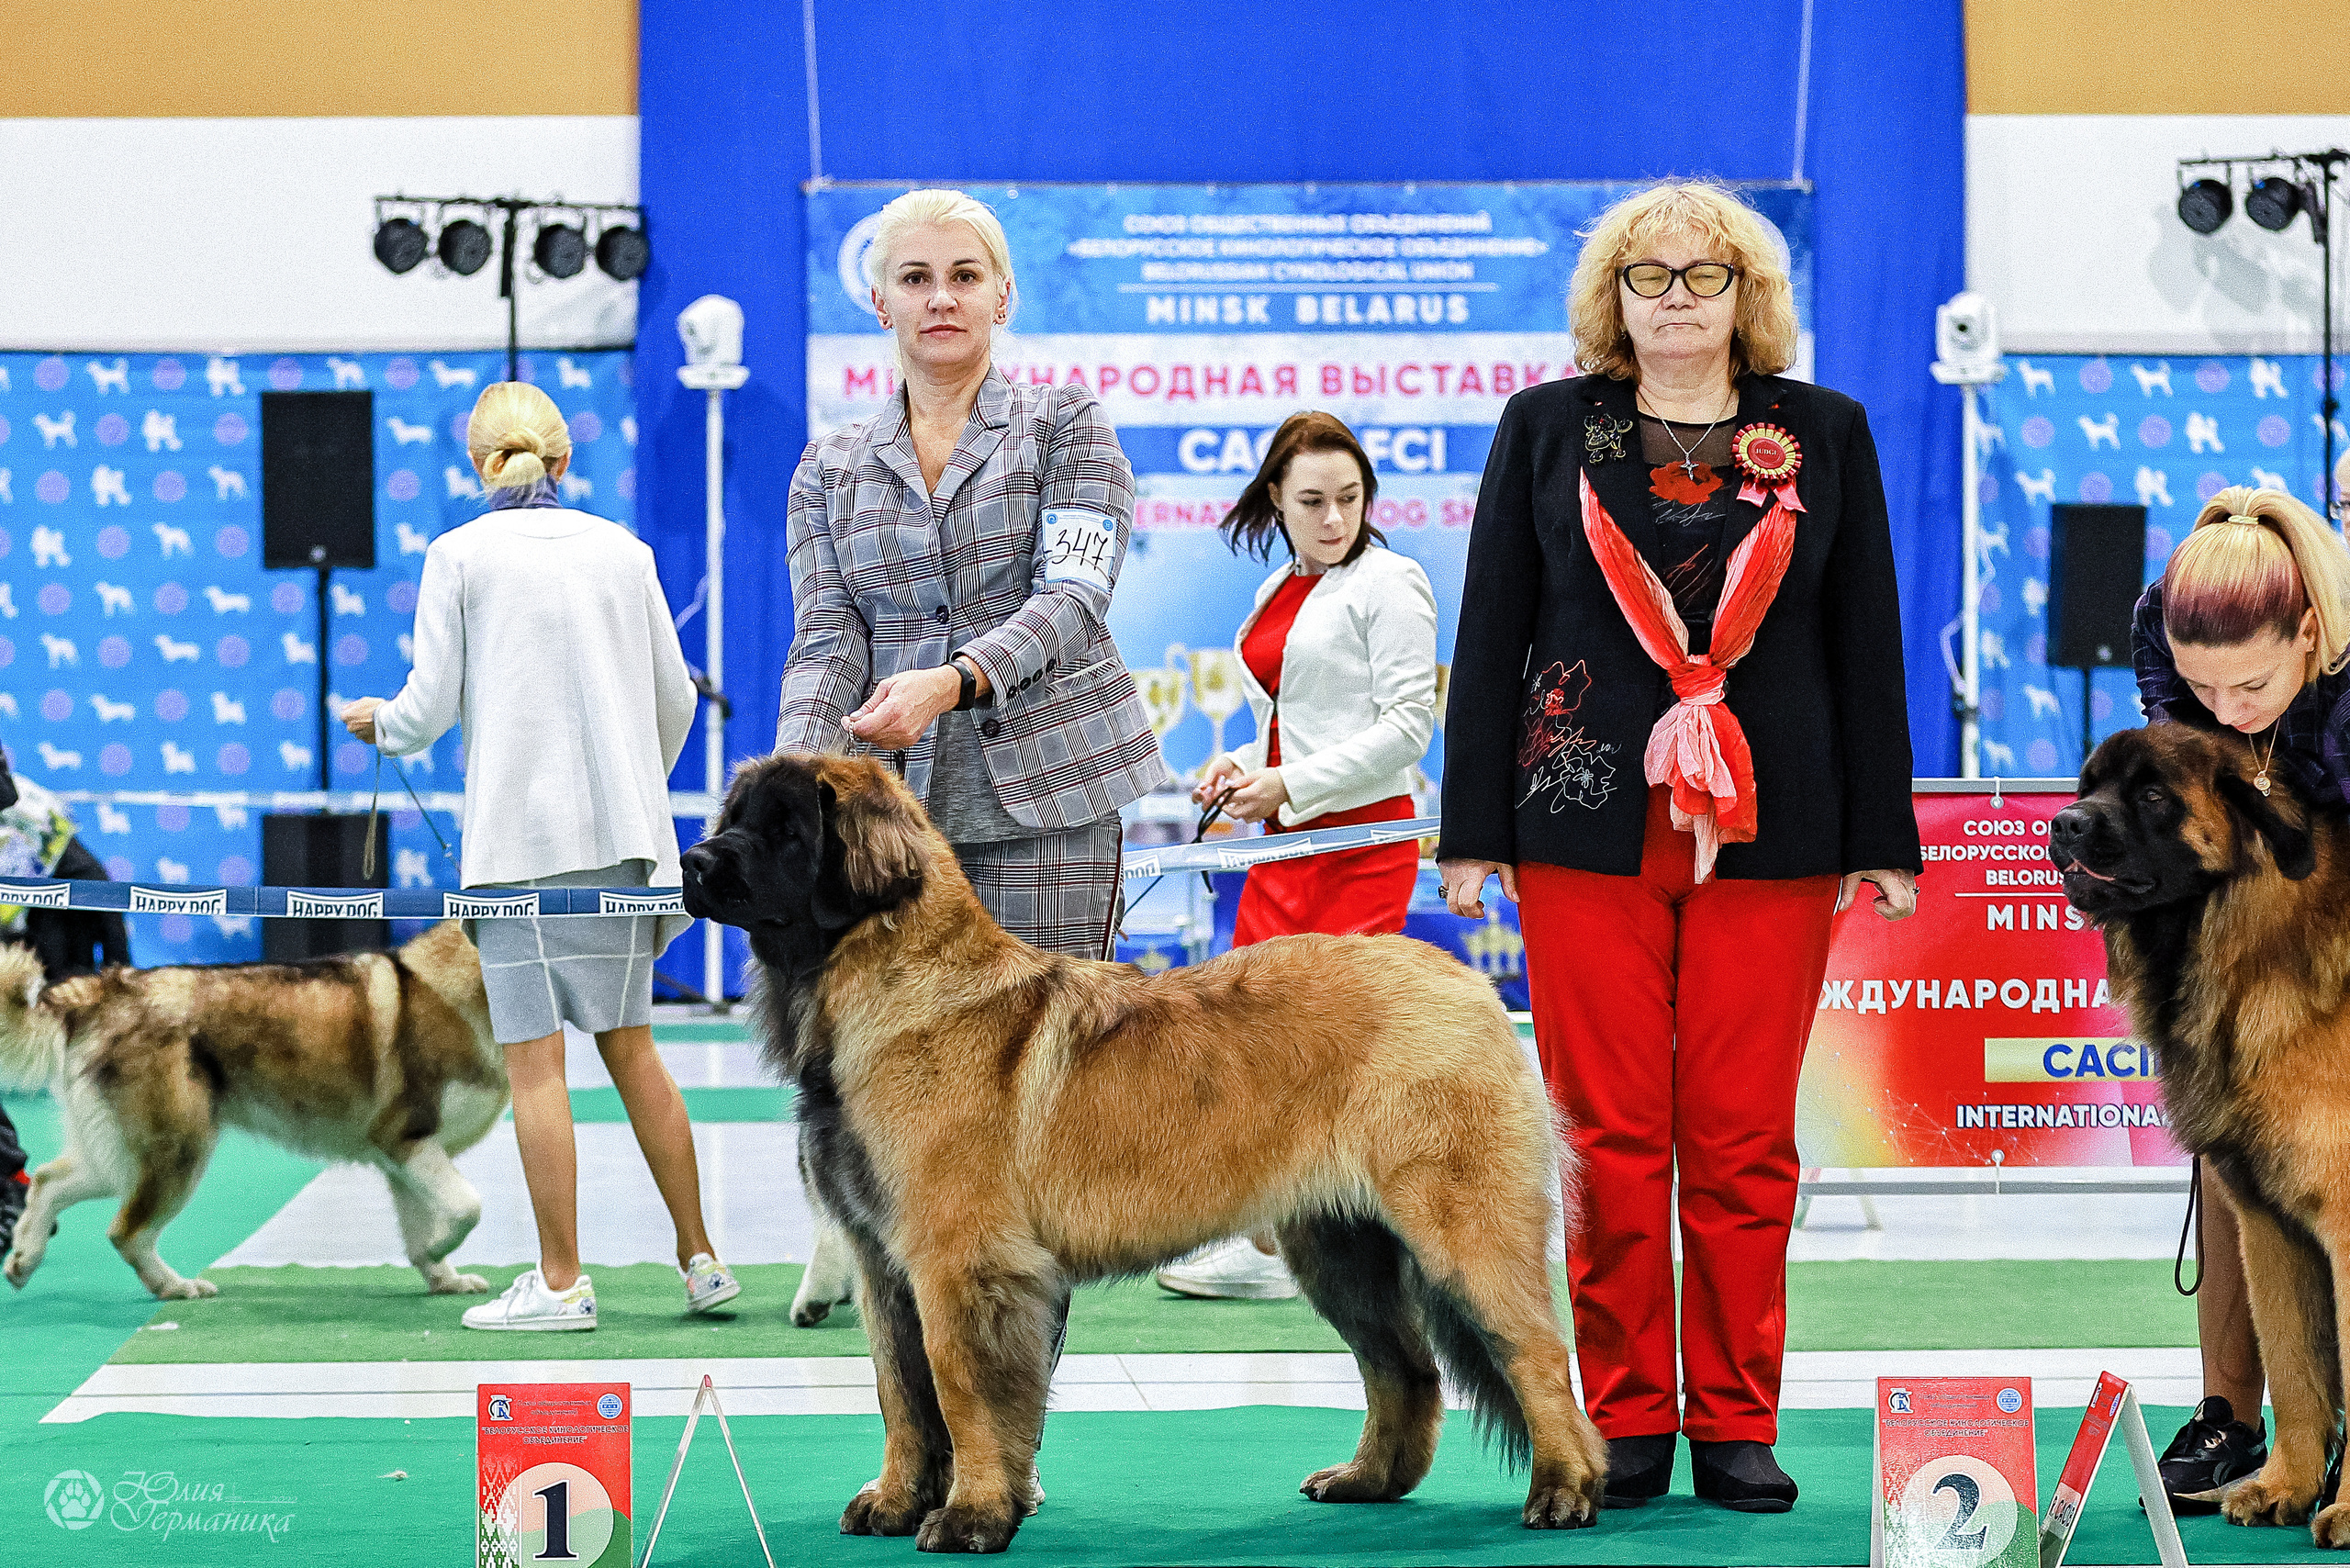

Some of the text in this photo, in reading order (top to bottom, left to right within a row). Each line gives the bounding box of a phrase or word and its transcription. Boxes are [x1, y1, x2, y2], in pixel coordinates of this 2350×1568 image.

[1147, 295, 1468, 324] MINSK BELARUS
[1051, 528, 1108, 571] 347
[1963, 820, 2026, 836] СОЮЗ
[137, 898, 221, 914] HAPPY DOG
[293, 901, 378, 917] HAPPY DOG
[450, 902, 534, 917] HAPPY DOG
[1986, 904, 2085, 931] MINS
[1819, 979, 2109, 1014] ЖДУНАРОДНА
[1956, 1104, 2163, 1128] INTERNATIONA
[532, 1479, 579, 1561] 1
[1931, 1473, 1988, 1551] 2
